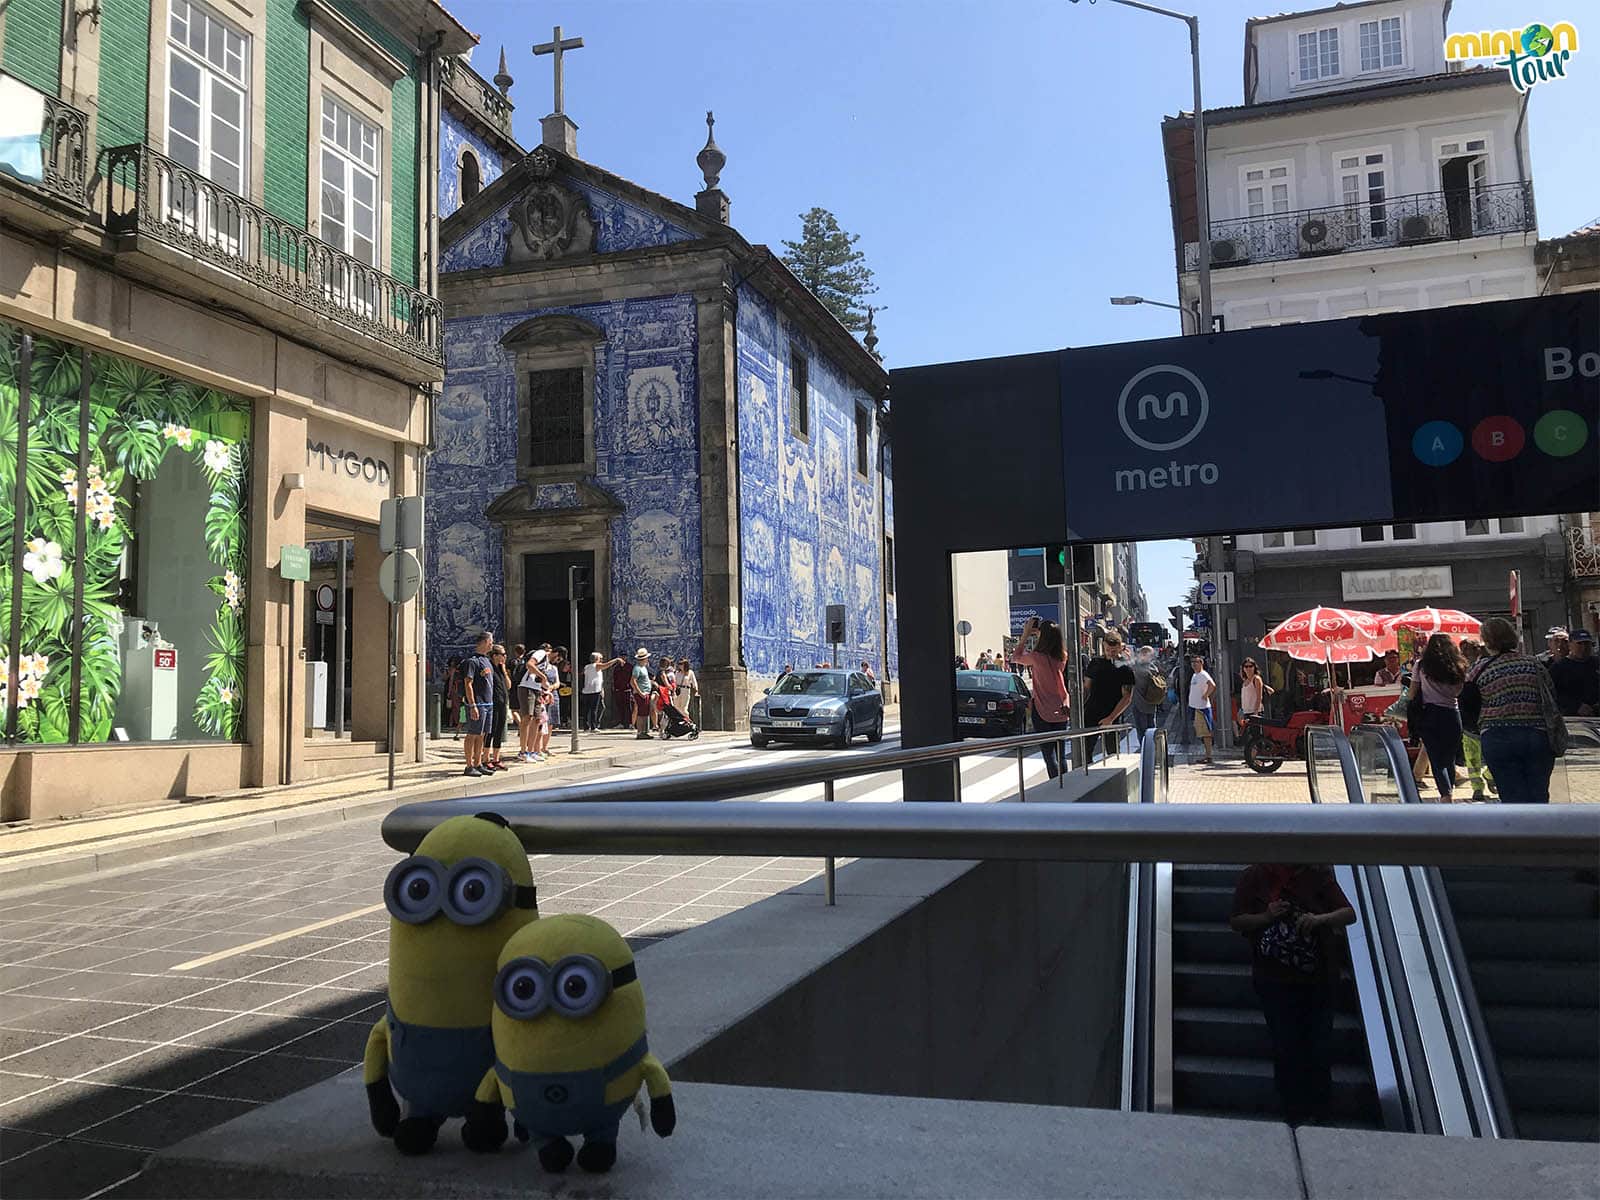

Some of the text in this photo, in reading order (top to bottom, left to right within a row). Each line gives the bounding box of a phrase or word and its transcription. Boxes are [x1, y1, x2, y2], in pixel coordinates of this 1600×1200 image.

[1431, 425, 1567, 451] A B C
[306, 438, 391, 486] MYGOD
[1114, 460, 1220, 492] metro
